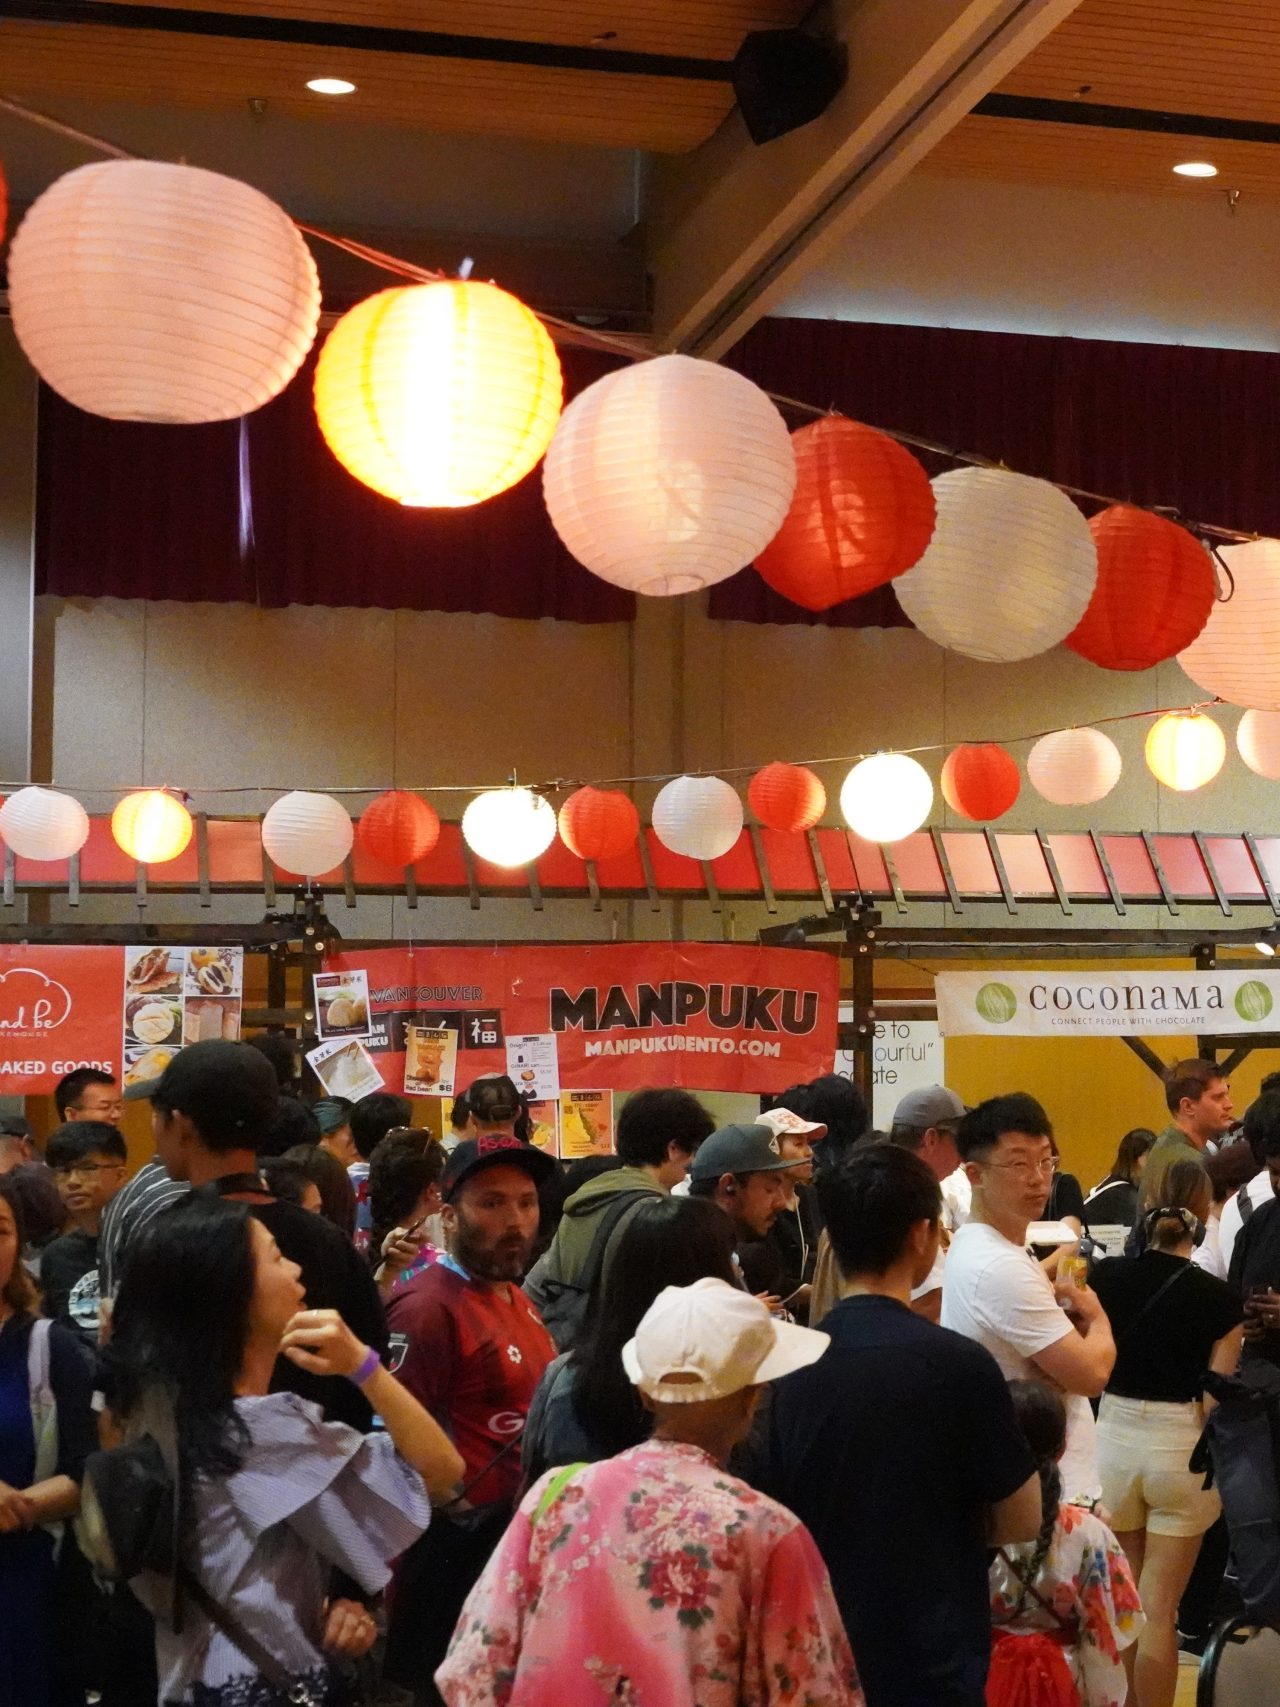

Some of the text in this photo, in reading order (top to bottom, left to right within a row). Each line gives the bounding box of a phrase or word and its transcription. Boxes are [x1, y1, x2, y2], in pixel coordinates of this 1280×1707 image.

[369, 986, 483, 1003] VANCOUVER
[550, 981, 819, 1036] MANPUKU
[1051, 1016, 1206, 1026] CONNECT PEOPLE WITH CHOCOLATE
[585, 1034, 781, 1057] MANPUKUBENTO.COM
[0, 1061, 46, 1075] AKED
